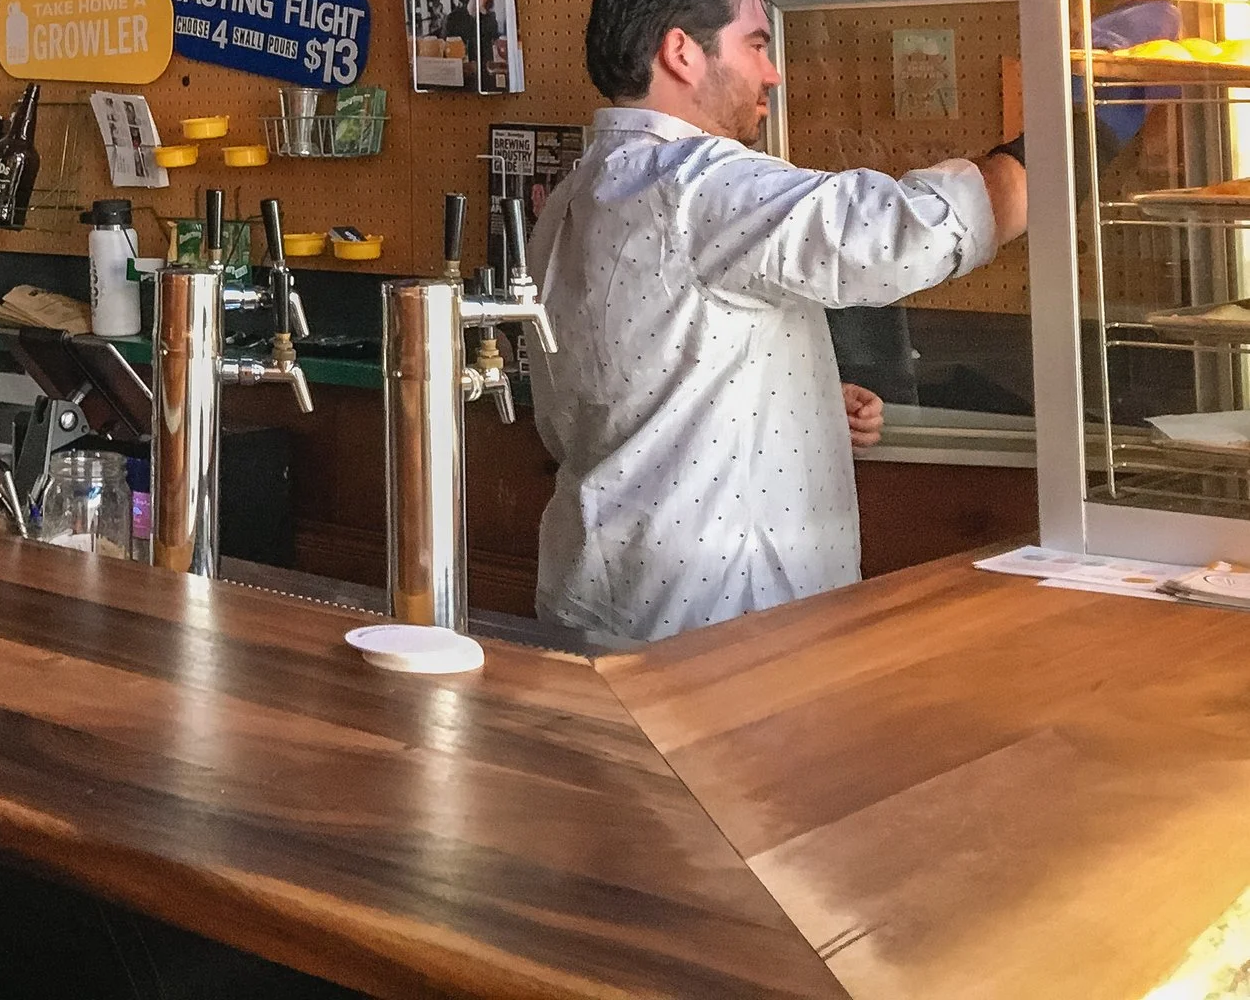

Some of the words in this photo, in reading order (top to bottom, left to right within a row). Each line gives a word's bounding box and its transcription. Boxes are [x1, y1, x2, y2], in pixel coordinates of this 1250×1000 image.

[32, 0, 74, 18] TAKE
[33, 14, 149, 61] GROWLER
[176, 17, 209, 37] CHOOSE
[211, 19, 228, 49] 4
[234, 29, 263, 48] SMALL
[269, 37, 297, 58] POURS
[304, 38, 359, 85] $13
[494, 138, 530, 150] BREWING
[494, 161, 518, 172] GUDE
